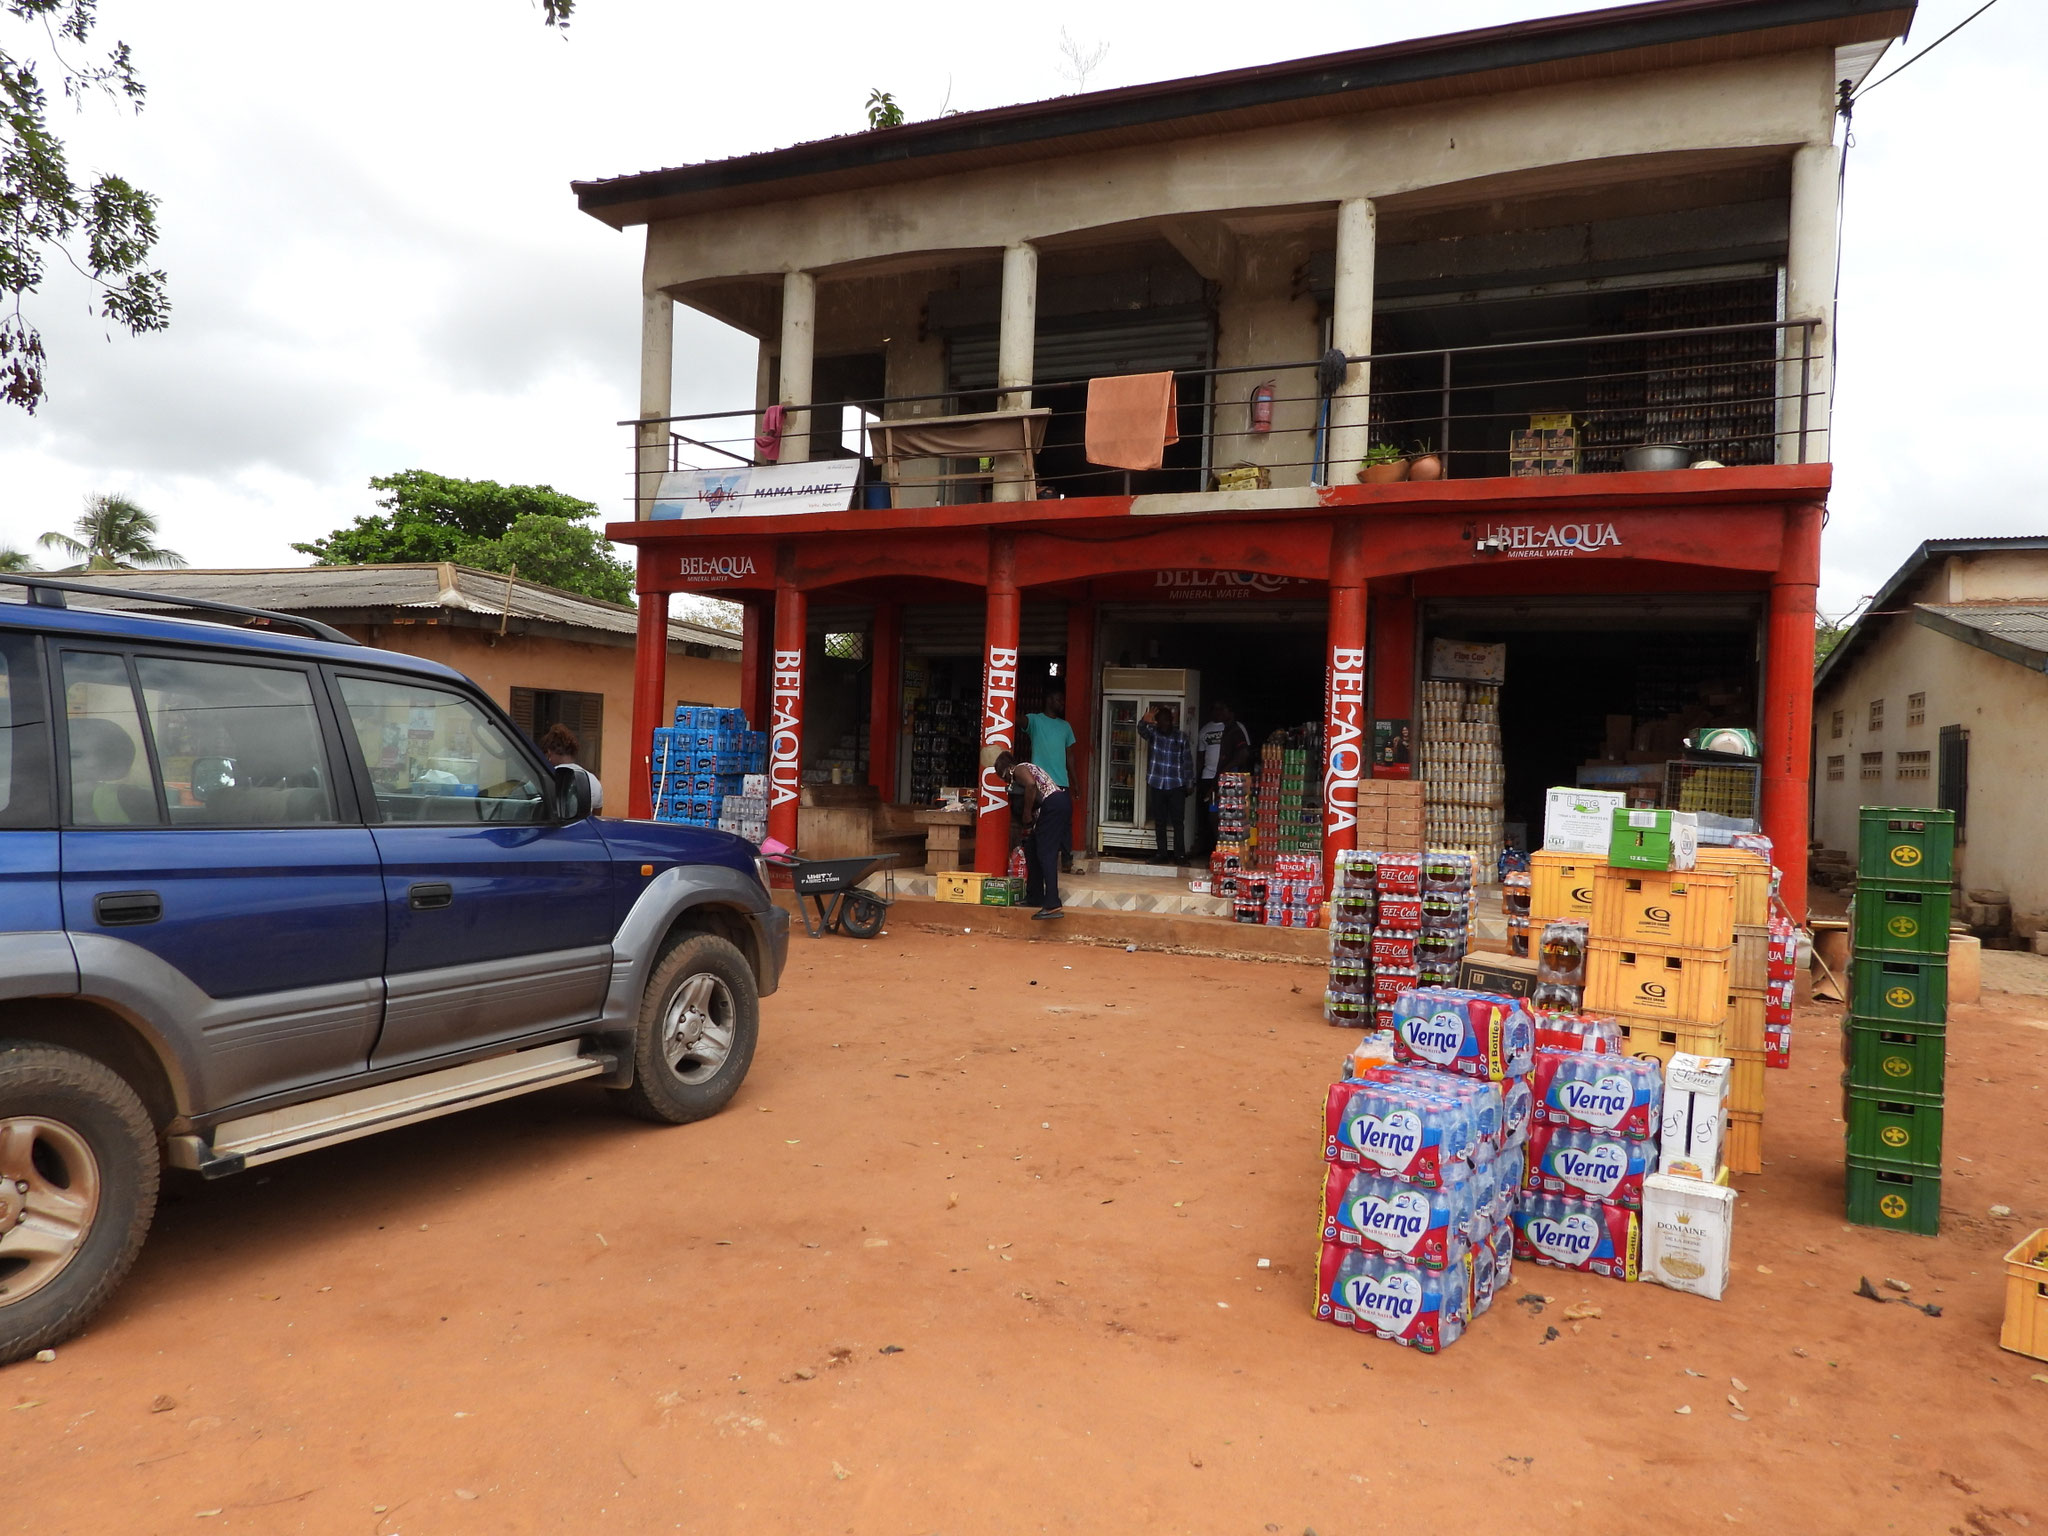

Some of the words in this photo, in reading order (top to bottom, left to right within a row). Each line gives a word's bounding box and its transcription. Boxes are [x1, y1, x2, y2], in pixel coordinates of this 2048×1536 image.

[754, 486, 794, 498] MAMA
[797, 483, 842, 496] JANET
[1507, 550, 1544, 558] MINERAL
[1546, 549, 1574, 557] WATER
[1169, 589, 1213, 599] MINERAL
[1216, 588, 1250, 598] WATER
[1567, 795, 1600, 809] Lime
[801, 877, 840, 885] FABRICATION
[806, 872, 833, 880] UNITY
[1407, 1021, 1457, 1053] Verna
[1491, 1020, 1500, 1058] Bottles
[1491, 1060, 1500, 1074] 24
[1566, 1085, 1625, 1115] Verna
[1356, 1120, 1415, 1156] Verna
[1561, 1153, 1620, 1183] Verna
[1359, 1201, 1423, 1238] Verna
[1657, 1221, 1707, 1238] DOMAINE
[1533, 1222, 1591, 1254] Verna
[1628, 1225, 1638, 1260] Bottles
[1628, 1265, 1636, 1276] 24
[1352, 1280, 1413, 1319] Verna
